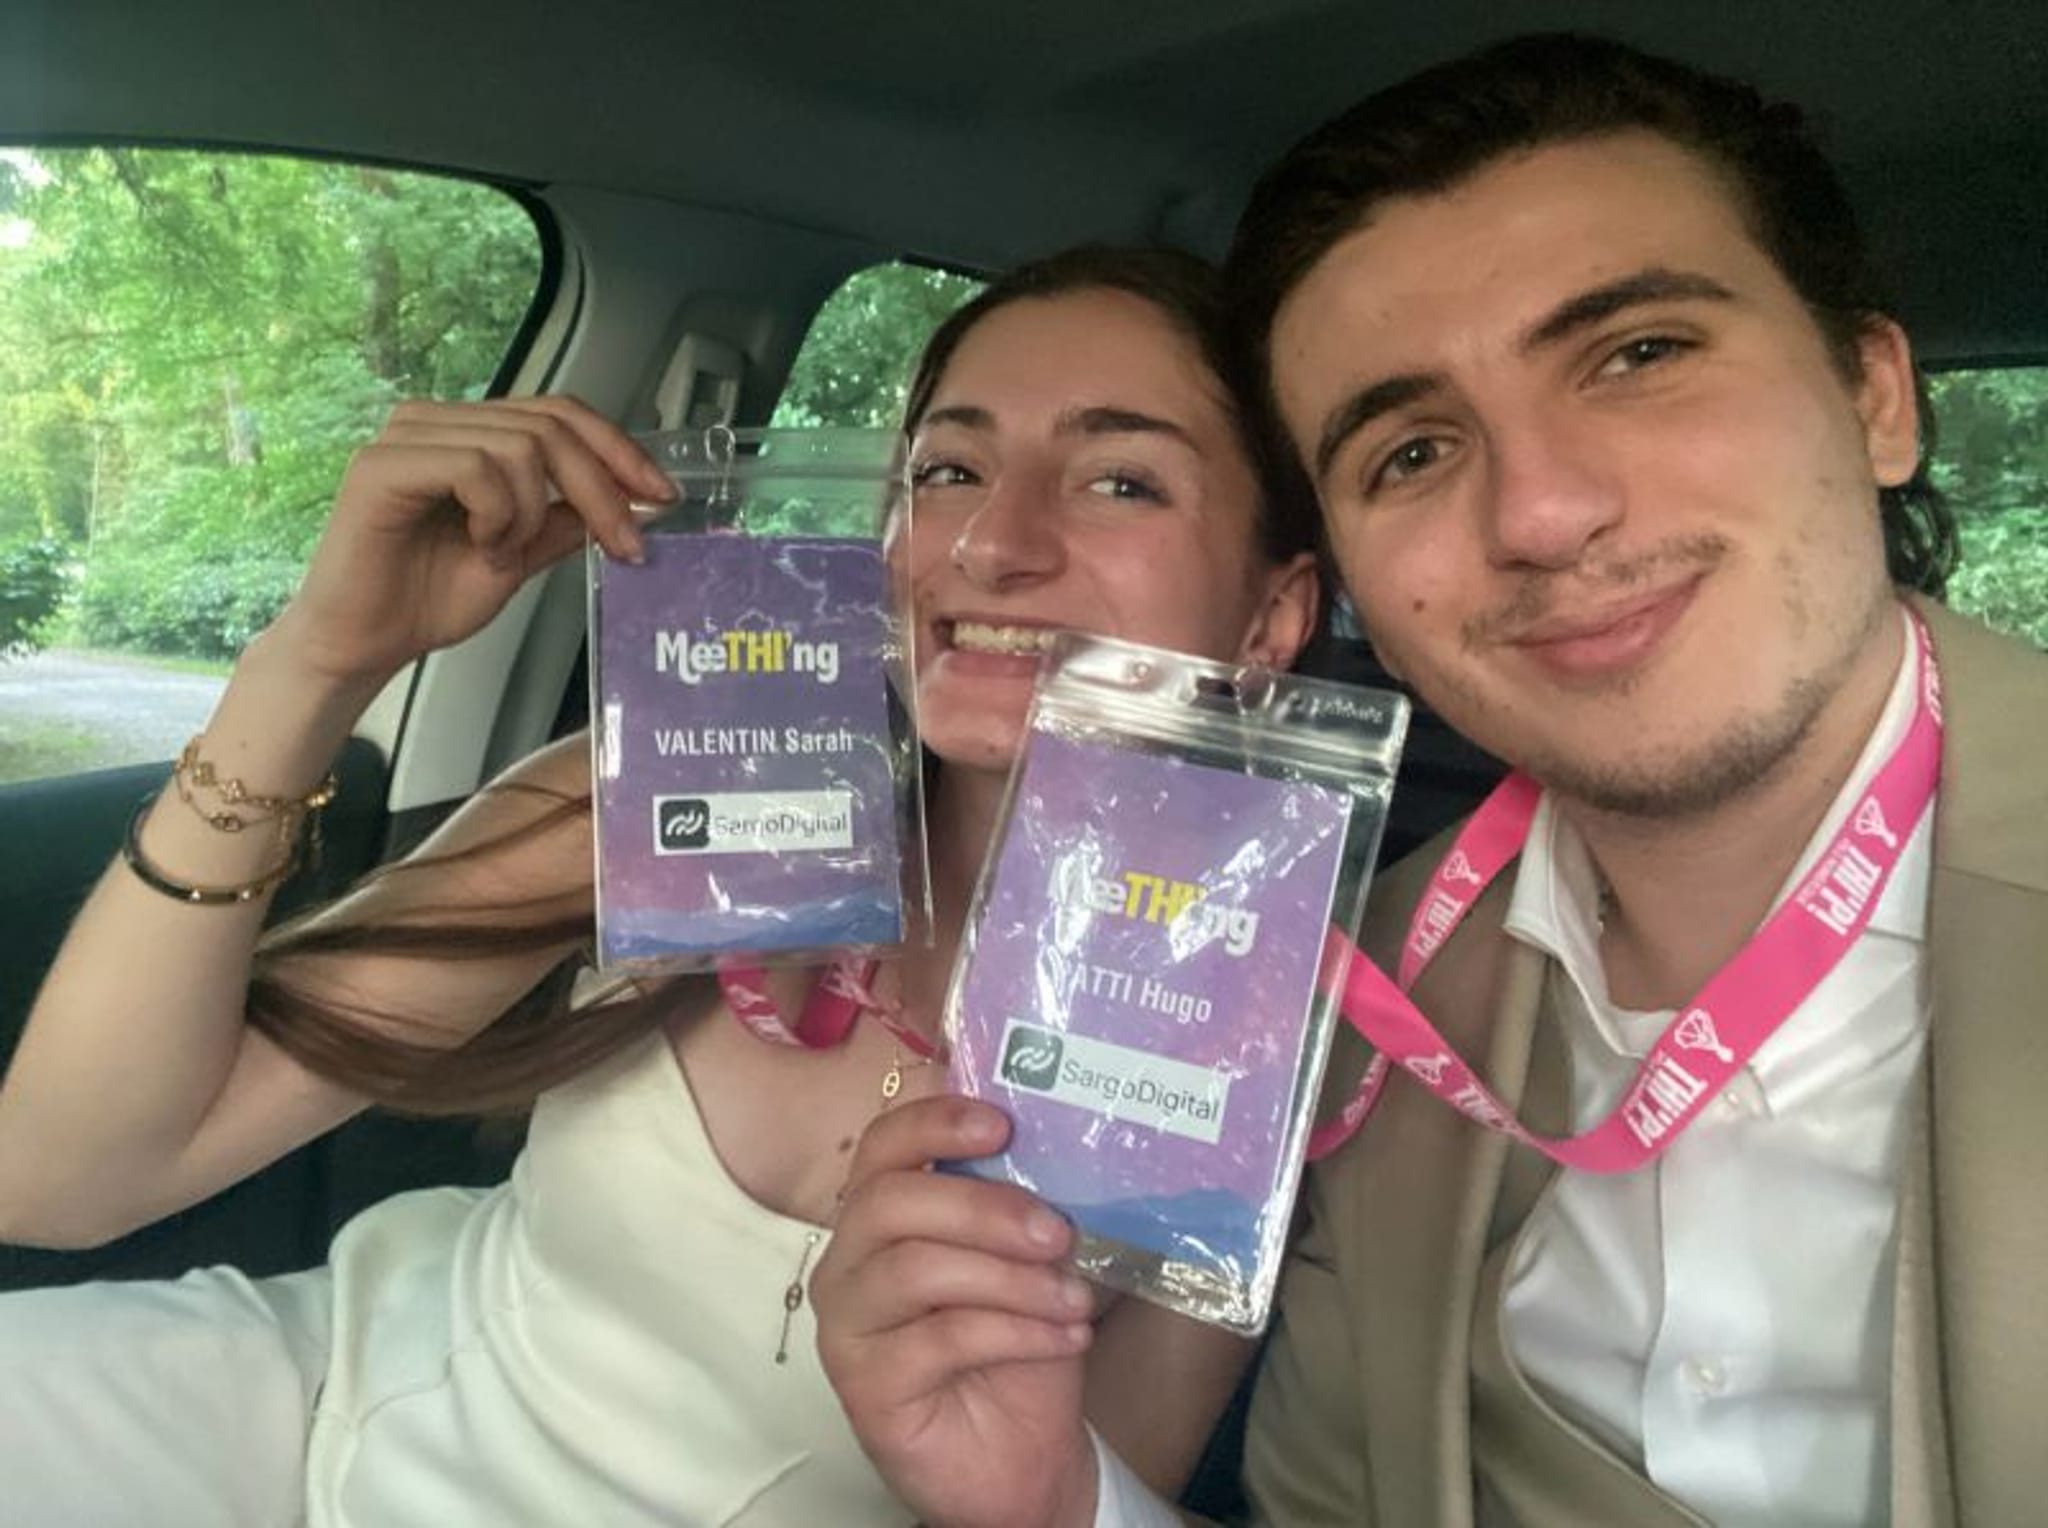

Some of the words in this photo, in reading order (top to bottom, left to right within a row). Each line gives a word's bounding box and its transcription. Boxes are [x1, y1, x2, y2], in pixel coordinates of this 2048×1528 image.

[655, 630, 839, 684] MeeTHI'ng
[654, 728, 776, 756] VALENTIN
[784, 727, 853, 755] Sarah
[1052, 957, 1133, 1004] ATTI
[1139, 978, 1212, 1025] Hugo
[1061, 1058, 1220, 1123] SargoDigital
